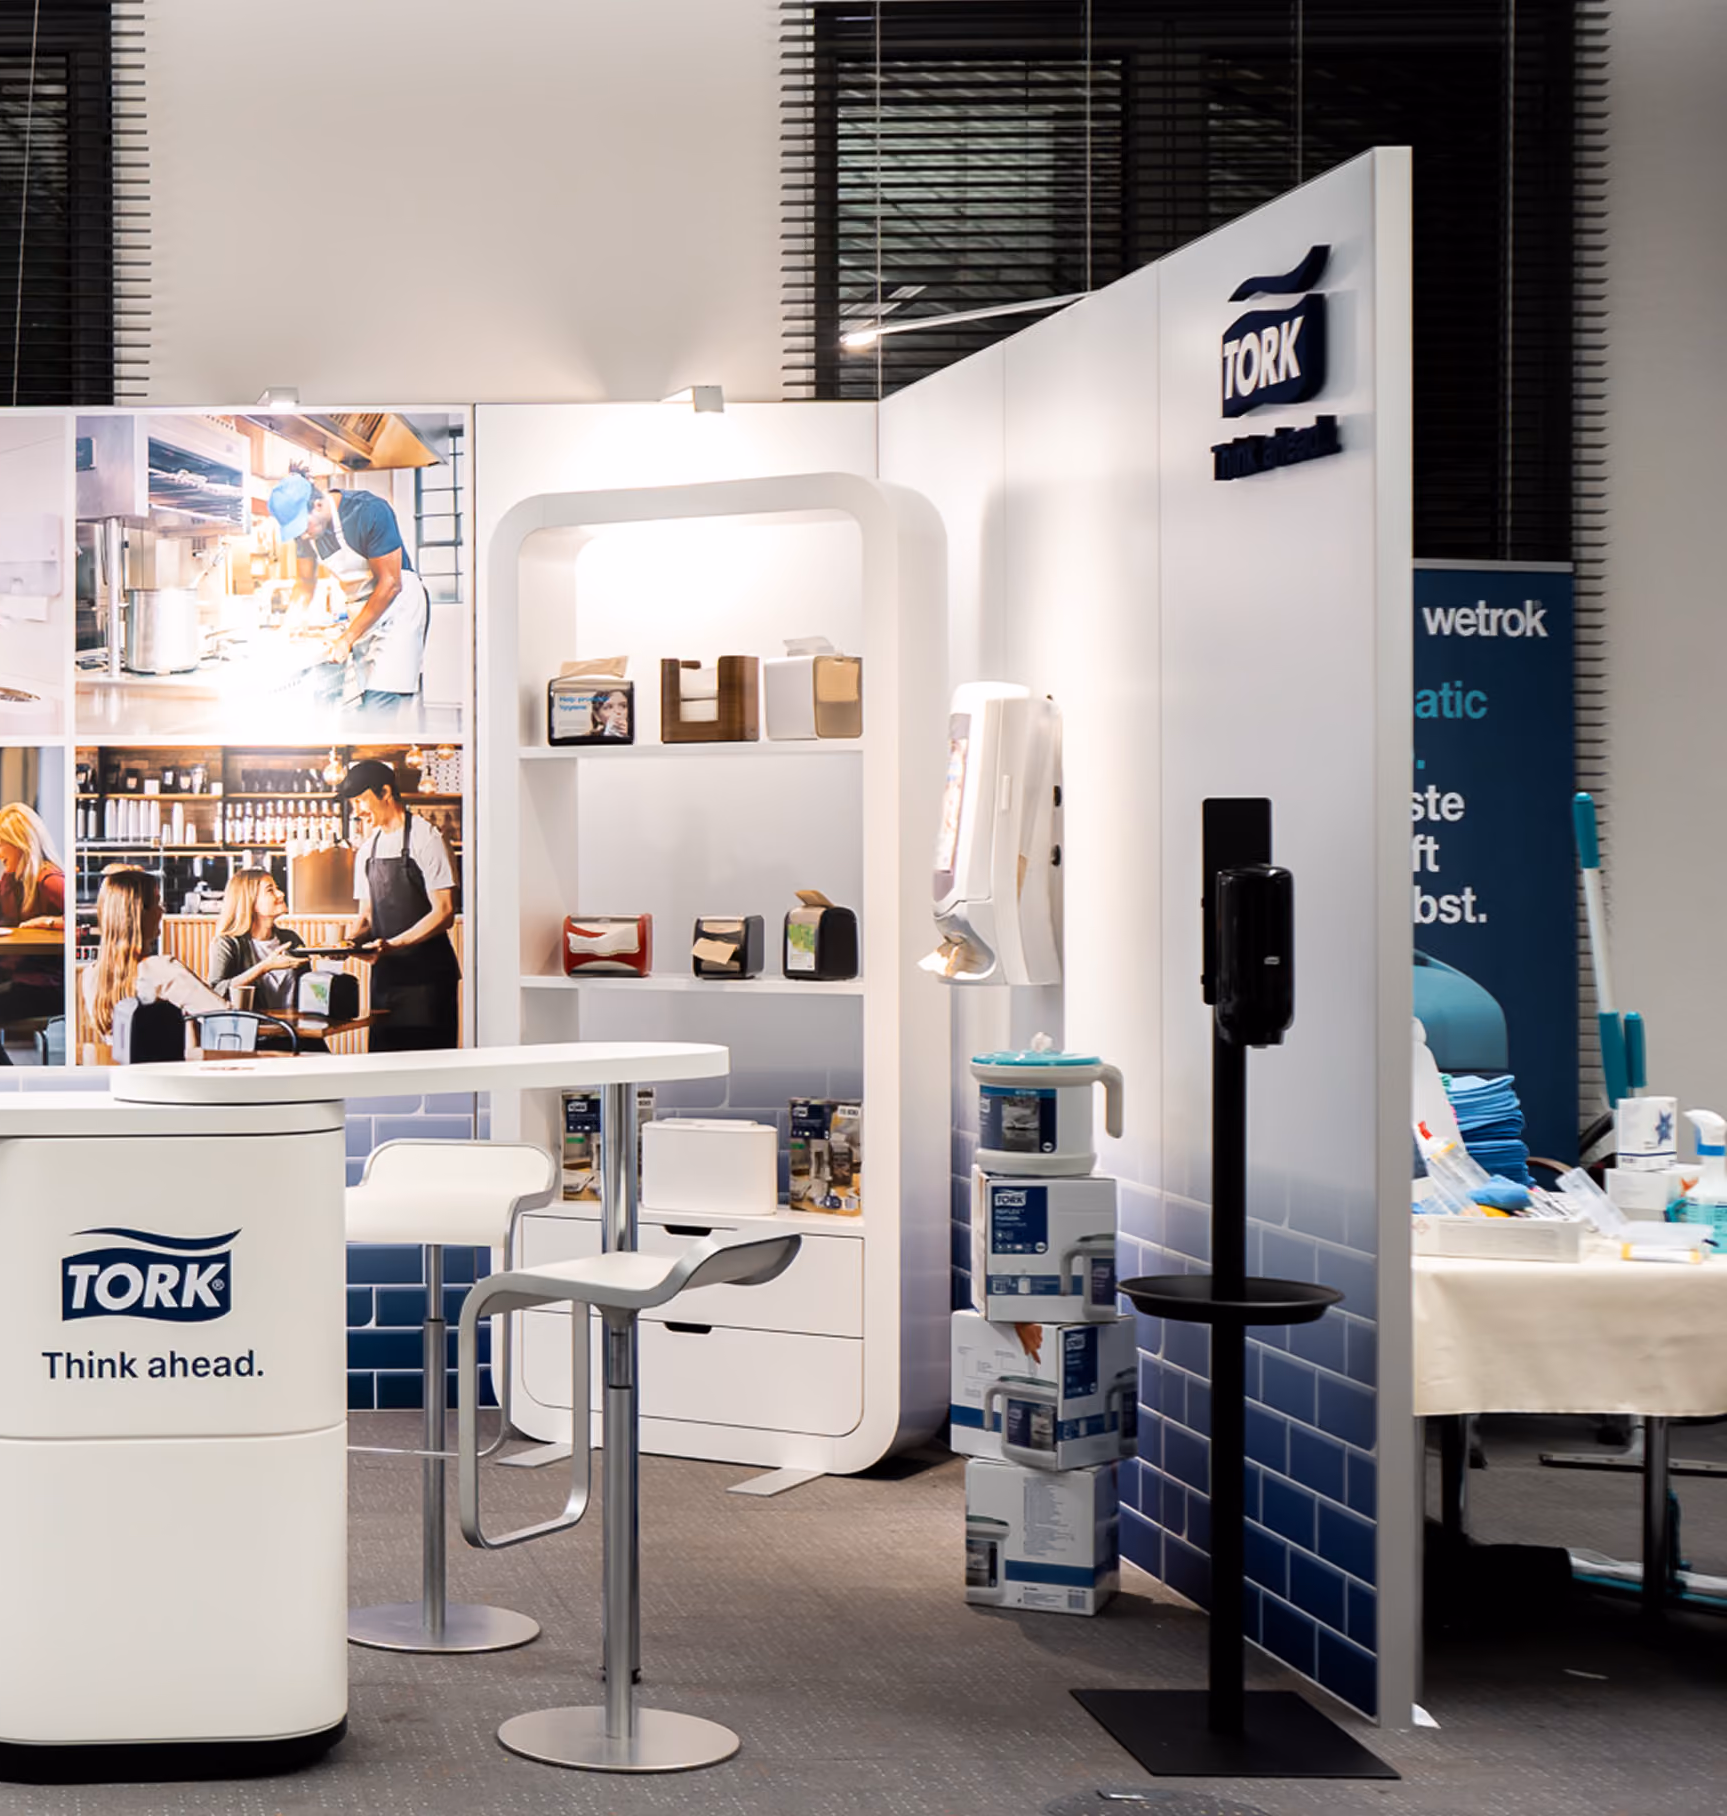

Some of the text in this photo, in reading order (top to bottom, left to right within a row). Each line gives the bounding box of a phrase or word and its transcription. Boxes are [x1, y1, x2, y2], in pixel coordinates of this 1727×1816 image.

[1224, 315, 1305, 400] TORK
[1422, 599, 1549, 638] wetrok
[1415, 680, 1488, 719] atic
[1411, 784, 1465, 822] ste
[1411, 833, 1440, 873] ft
[1413, 885, 1487, 925] bst.
[41, 1349, 265, 1381] Think ahead.
